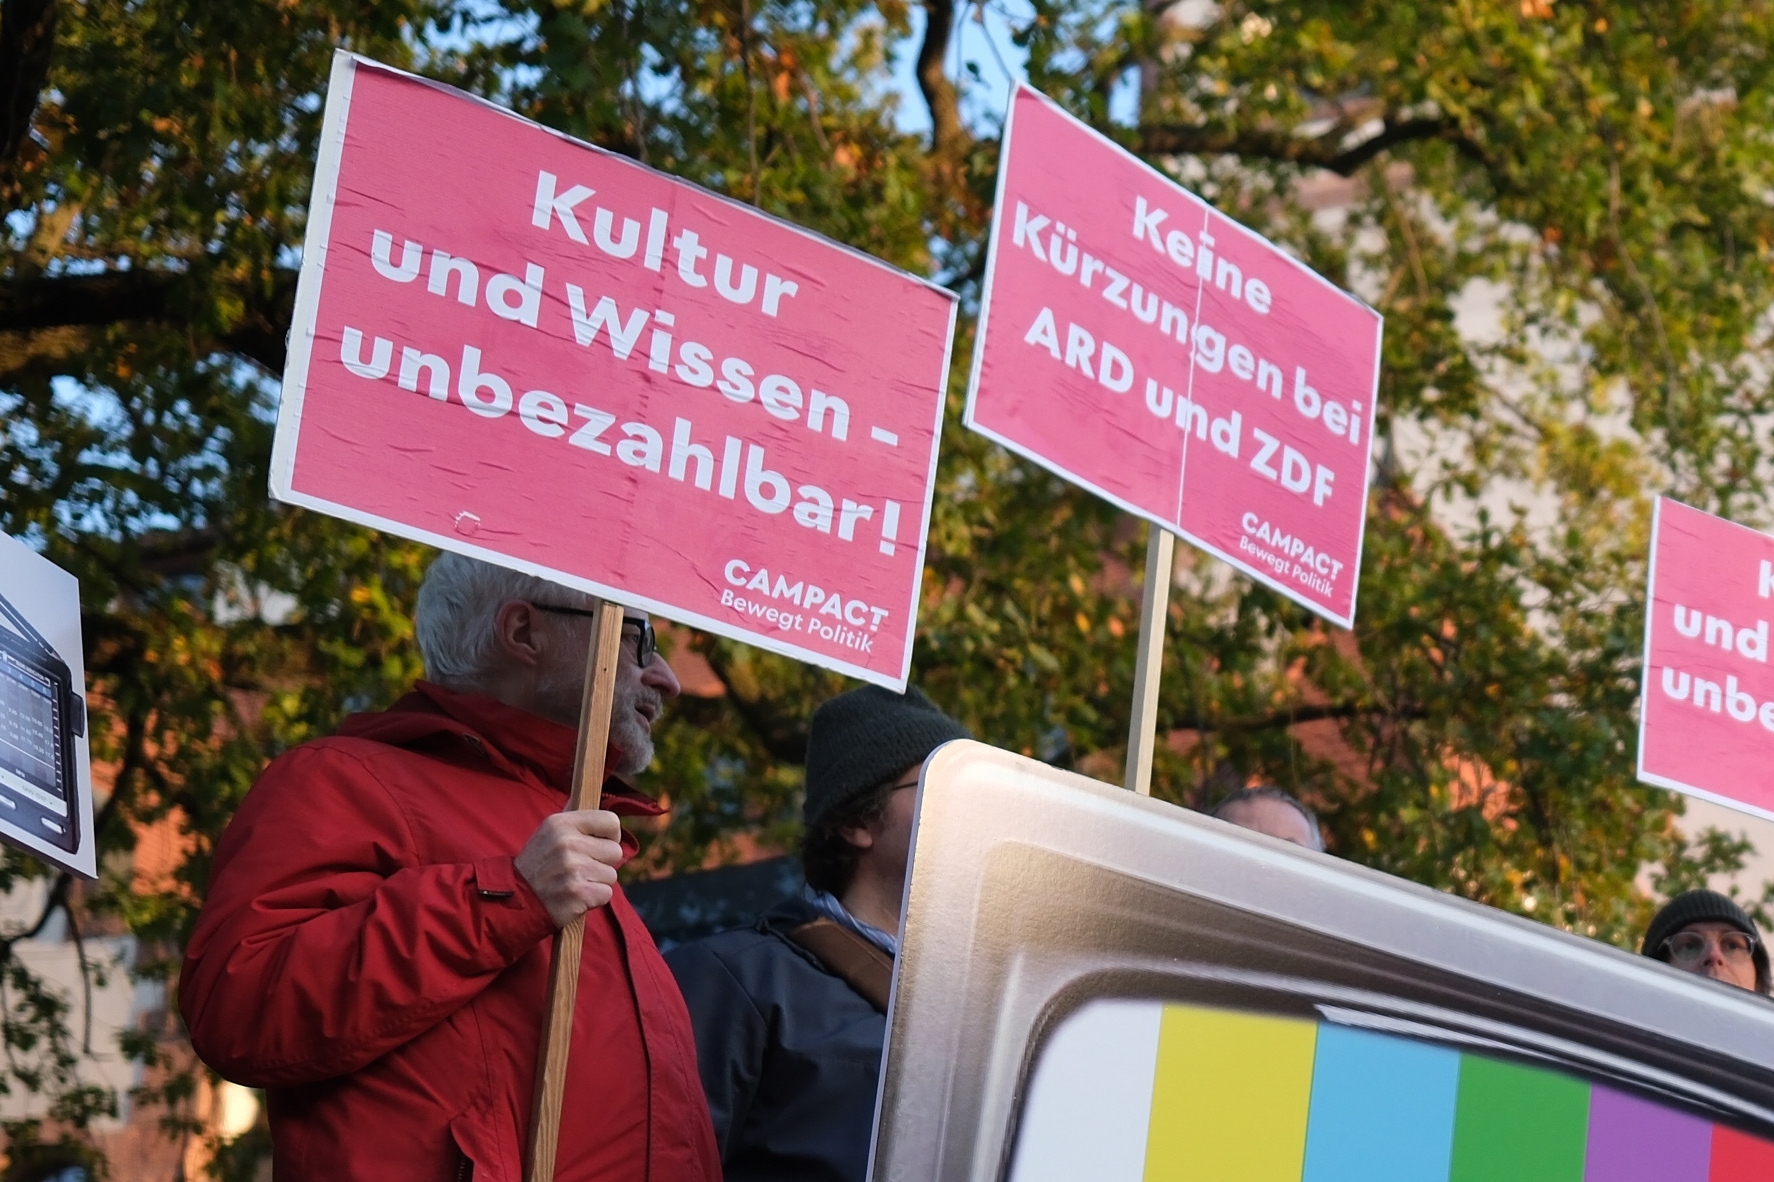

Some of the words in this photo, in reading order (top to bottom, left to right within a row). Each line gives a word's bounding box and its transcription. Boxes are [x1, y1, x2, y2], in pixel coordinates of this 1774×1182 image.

[531, 170, 799, 317] Kultur
[1133, 195, 1273, 314] Keine
[371, 229, 545, 328] und
[565, 282, 850, 441] Wissen
[1012, 200, 1282, 400] Kürzungen
[1294, 366, 1362, 445] bei
[340, 326, 901, 557] unbezahlbar!
[1024, 306, 1134, 393] ARD
[1144, 378, 1242, 459] und
[1250, 426, 1336, 507] ZDF
[723, 558, 889, 628] CAMPACT
[1239, 535, 1290, 575] Bewegt
[1292, 563, 1334, 598] Politik
[1242, 512, 1343, 581] CAMPACT
[721, 588, 803, 632] Bewegt
[807, 616, 875, 654] Politik
[1673, 604, 1769, 662] und
